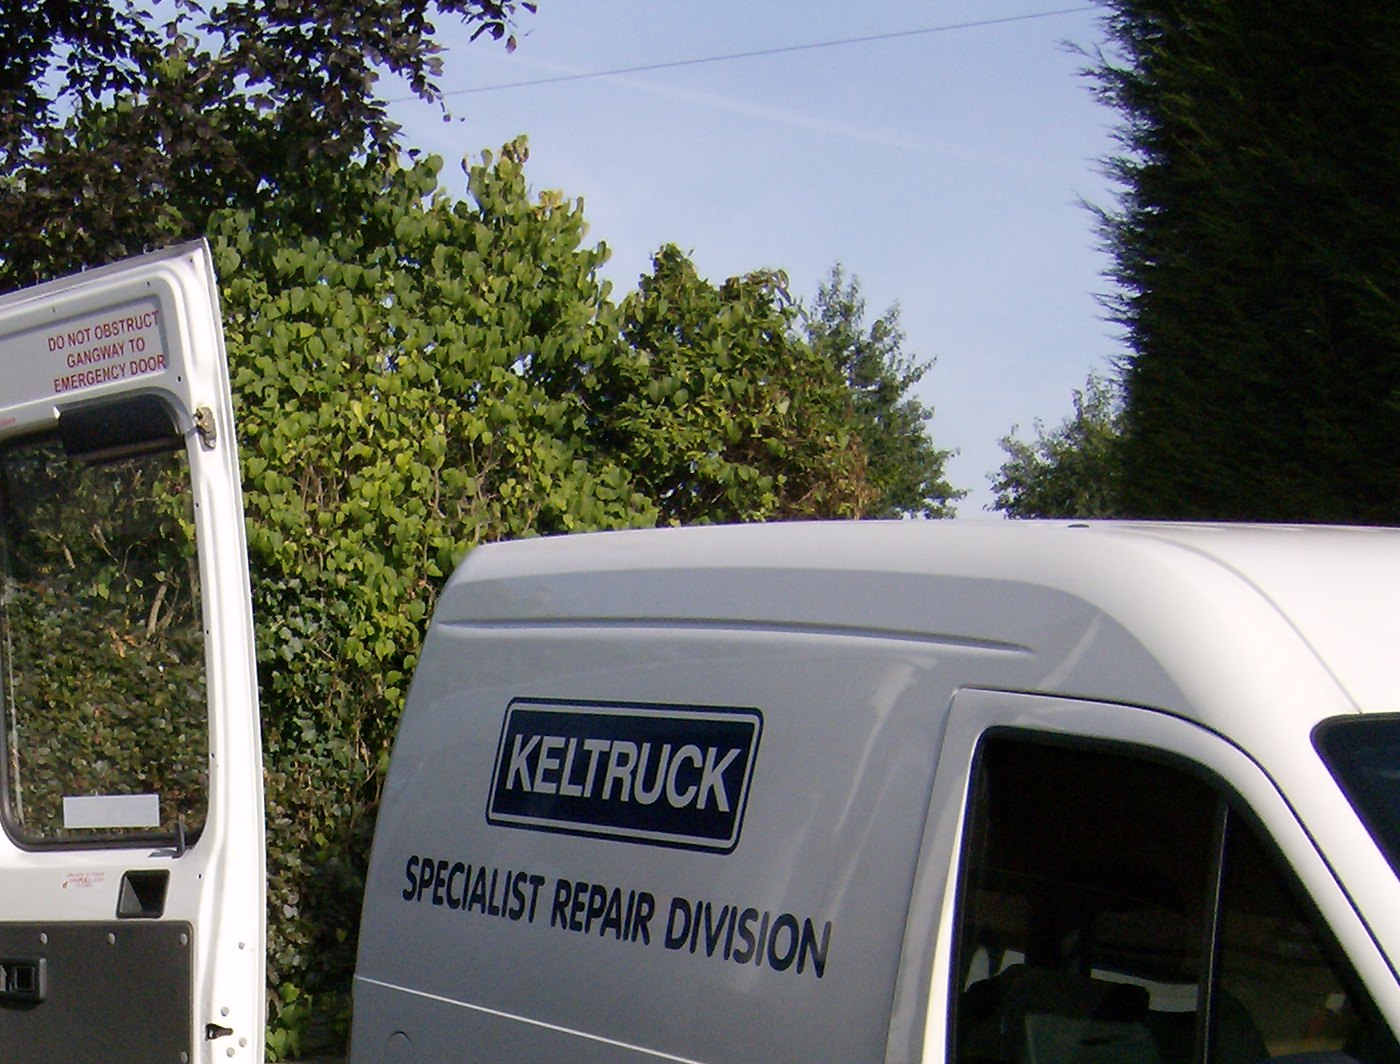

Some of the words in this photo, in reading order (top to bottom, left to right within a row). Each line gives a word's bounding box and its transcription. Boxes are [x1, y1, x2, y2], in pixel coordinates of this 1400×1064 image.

[48, 335, 65, 351] DO
[68, 328, 91, 347] NOT
[94, 310, 160, 340] OBSTRUCT
[66, 342, 125, 368] GANGWAY
[129, 337, 145, 353] TO
[53, 363, 126, 393] EMERGENCY
[130, 354, 167, 376] DOOR
[504, 733, 742, 814] KELTRUCK
[402, 855, 546, 925] SPECIALIST
[551, 878, 656, 947] REPAIR
[664, 896, 833, 979] DIVISION
